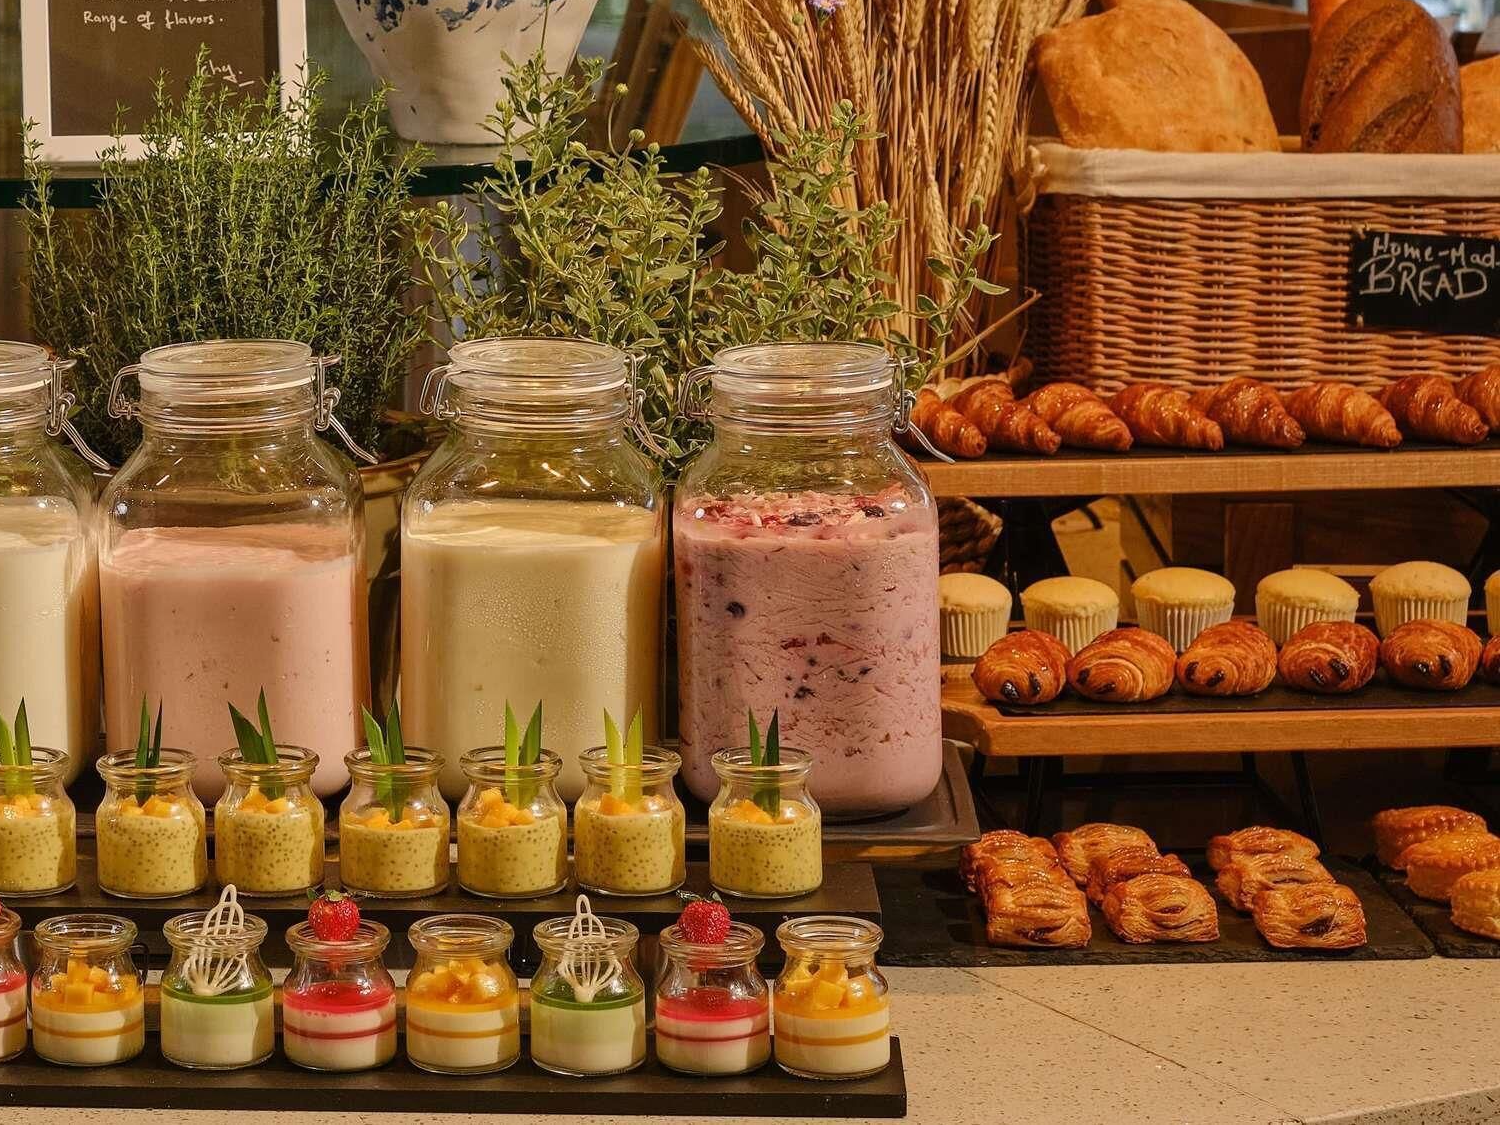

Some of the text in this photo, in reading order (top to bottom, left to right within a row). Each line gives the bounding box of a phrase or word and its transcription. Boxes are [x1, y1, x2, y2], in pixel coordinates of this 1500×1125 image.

[83, 9, 224, 32] Range of flavors.
[1373, 233, 1500, 269] Home-Mad
[1358, 254, 1488, 306] BREAD
